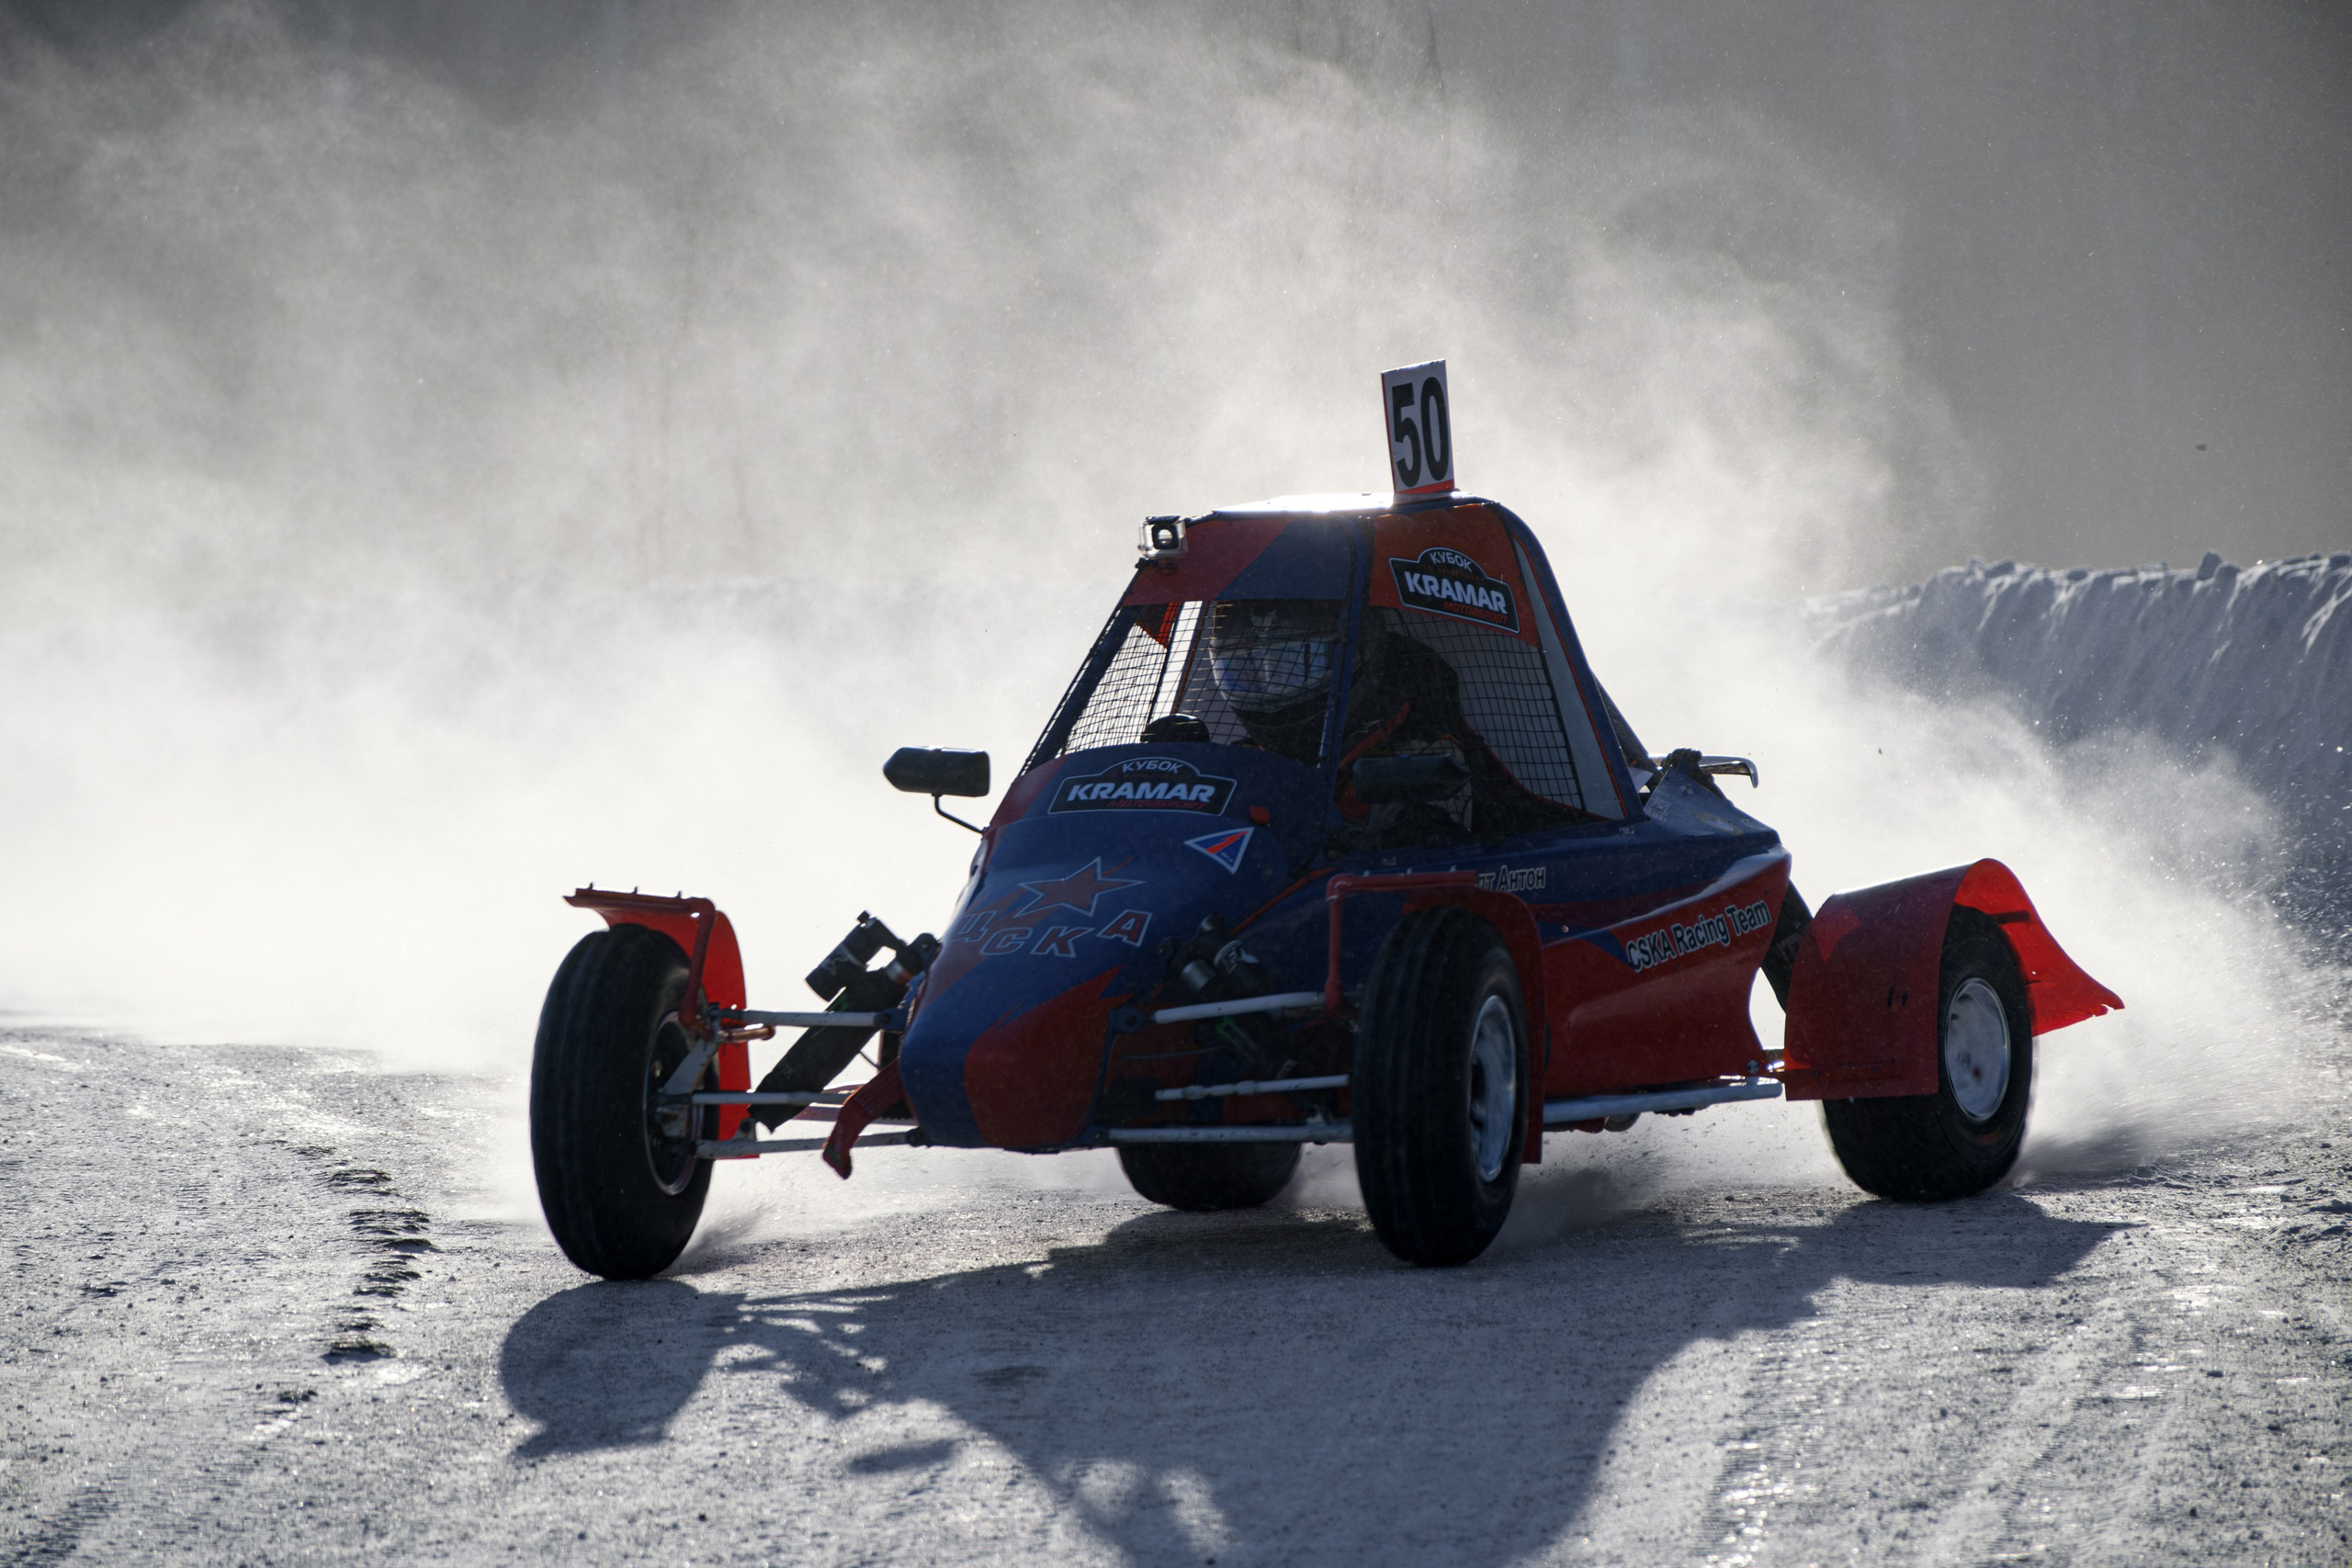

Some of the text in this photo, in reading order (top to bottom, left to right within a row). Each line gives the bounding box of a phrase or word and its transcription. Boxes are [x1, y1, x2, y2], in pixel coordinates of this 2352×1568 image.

[1392, 377, 1449, 488] 50
[1430, 551, 1473, 572] КУБОК
[1404, 570, 1508, 615] KRAMAR
[1442, 600, 1509, 625] MOTORSPORT
[1122, 760, 1184, 775] КУБОК
[1067, 782, 1216, 803] KRAMAR
[1106, 799, 1212, 810] MOTORSPORT
[945, 908, 1153, 958] ЦСКА
[1626, 929, 1677, 974] CSKA
[1670, 914, 1731, 957] Racing
[1724, 899, 1772, 937] Team
